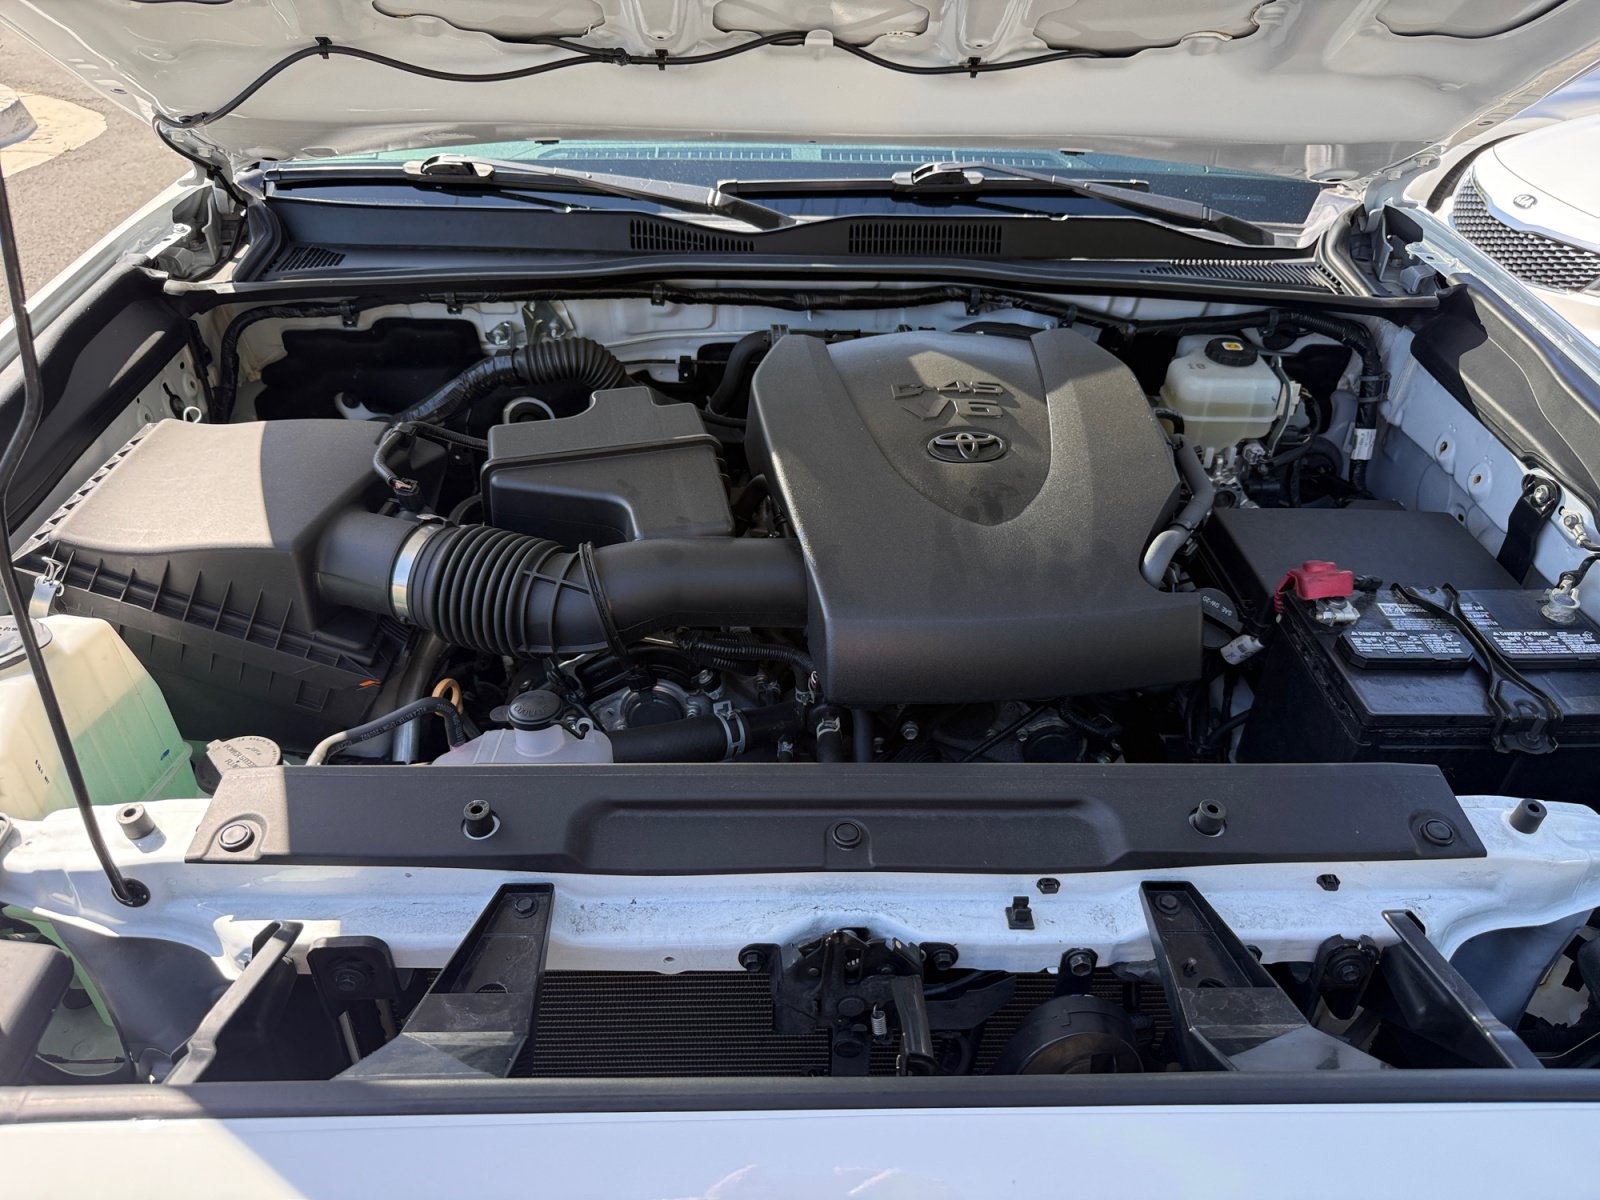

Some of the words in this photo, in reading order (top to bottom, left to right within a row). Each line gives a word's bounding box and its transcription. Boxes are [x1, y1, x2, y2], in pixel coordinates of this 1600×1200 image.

[891, 380, 1004, 401] D-4S
[902, 398, 1004, 421] V6
[1202, 595, 1220, 609] 0W-20
[1221, 605, 1233, 617] SAE
[223, 743, 241, 758] POWER
